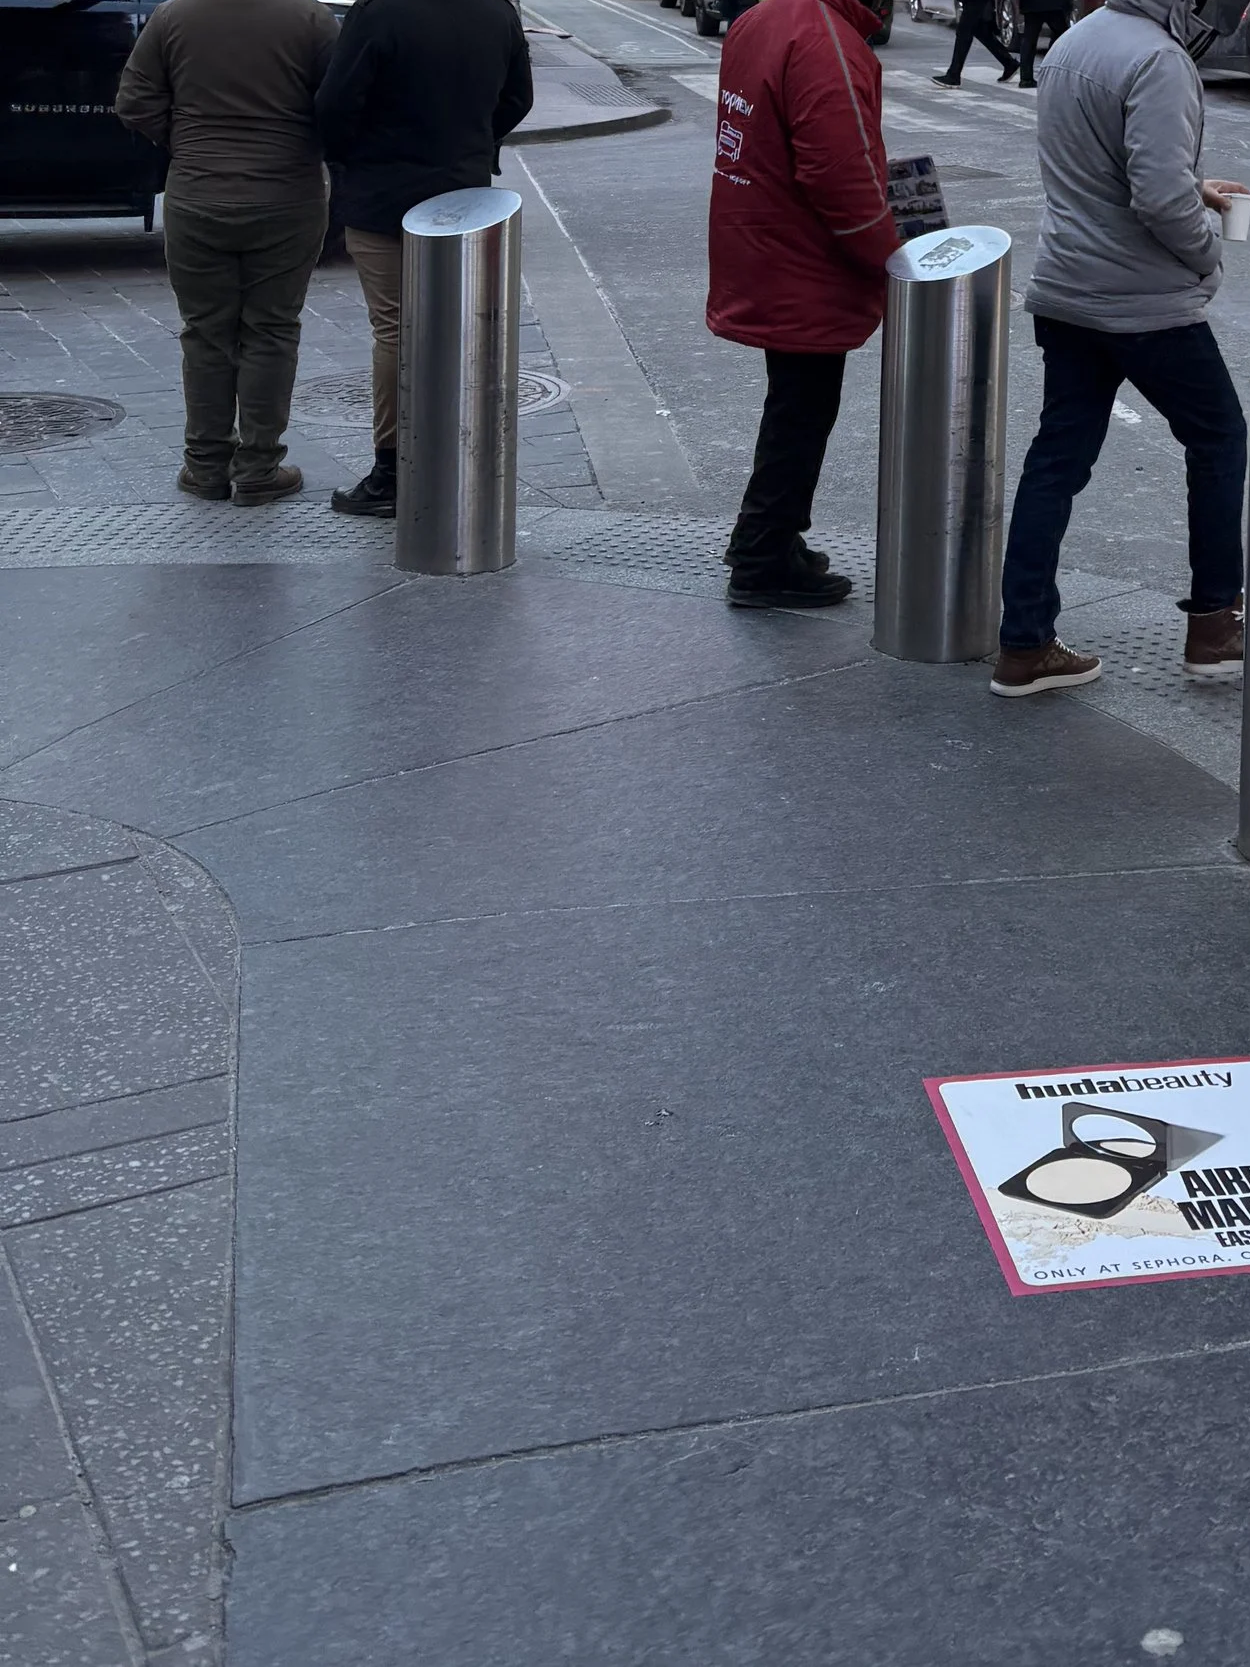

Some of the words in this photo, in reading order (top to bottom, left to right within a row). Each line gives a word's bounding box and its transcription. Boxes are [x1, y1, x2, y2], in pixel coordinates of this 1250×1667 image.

[1015, 1069, 1232, 1100] hudabeauty
[1034, 1267, 1088, 1280] ONLY
[1099, 1263, 1120, 1274] AT
[1133, 1253, 1231, 1271] SEPHORA.
